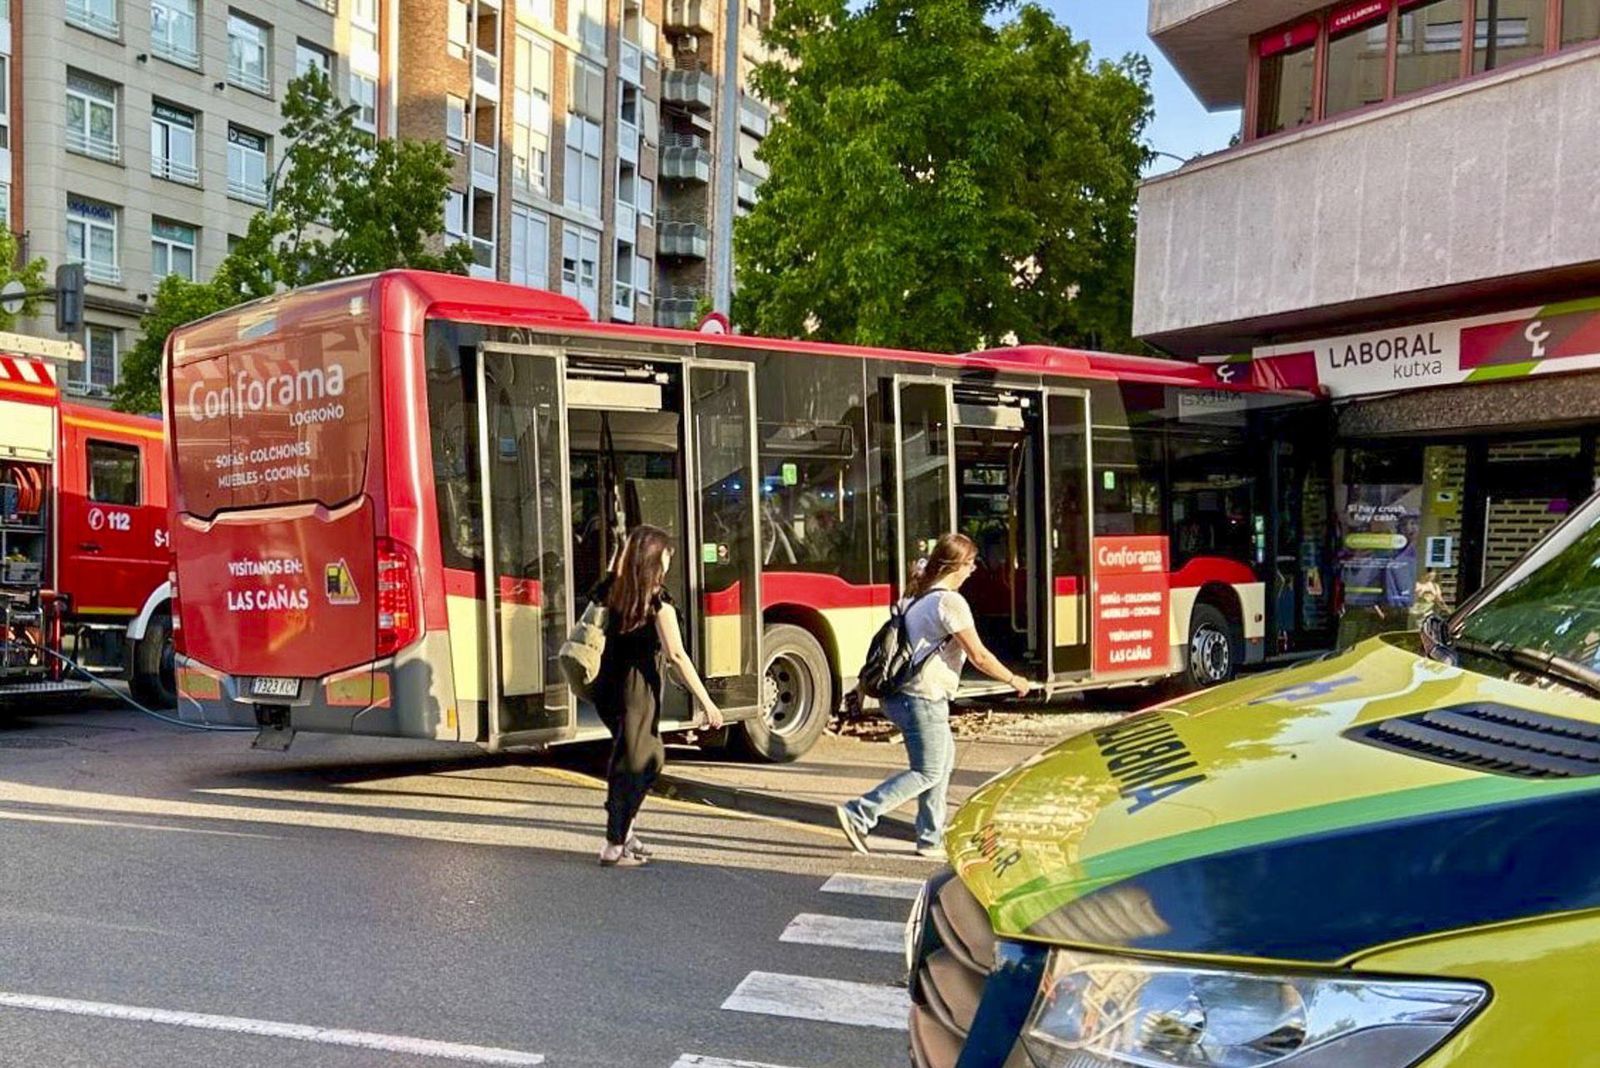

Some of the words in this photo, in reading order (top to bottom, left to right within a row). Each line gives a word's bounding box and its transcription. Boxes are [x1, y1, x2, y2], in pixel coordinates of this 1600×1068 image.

[1329, 332, 1442, 369] LABORAL
[1393, 360, 1442, 379] kutxa
[188, 363, 344, 421] Conforama
[289, 402, 345, 427] LOGROÑO
[250, 441, 311, 463] COLCHONES
[264, 464, 310, 482] COCINAS
[107, 511, 131, 531] 112
[228, 558, 282, 576] VISÍTANOS
[1098, 546, 1162, 567] Conforama
[227, 590, 254, 611] LAS
[256, 584, 309, 610] CAÑAS
